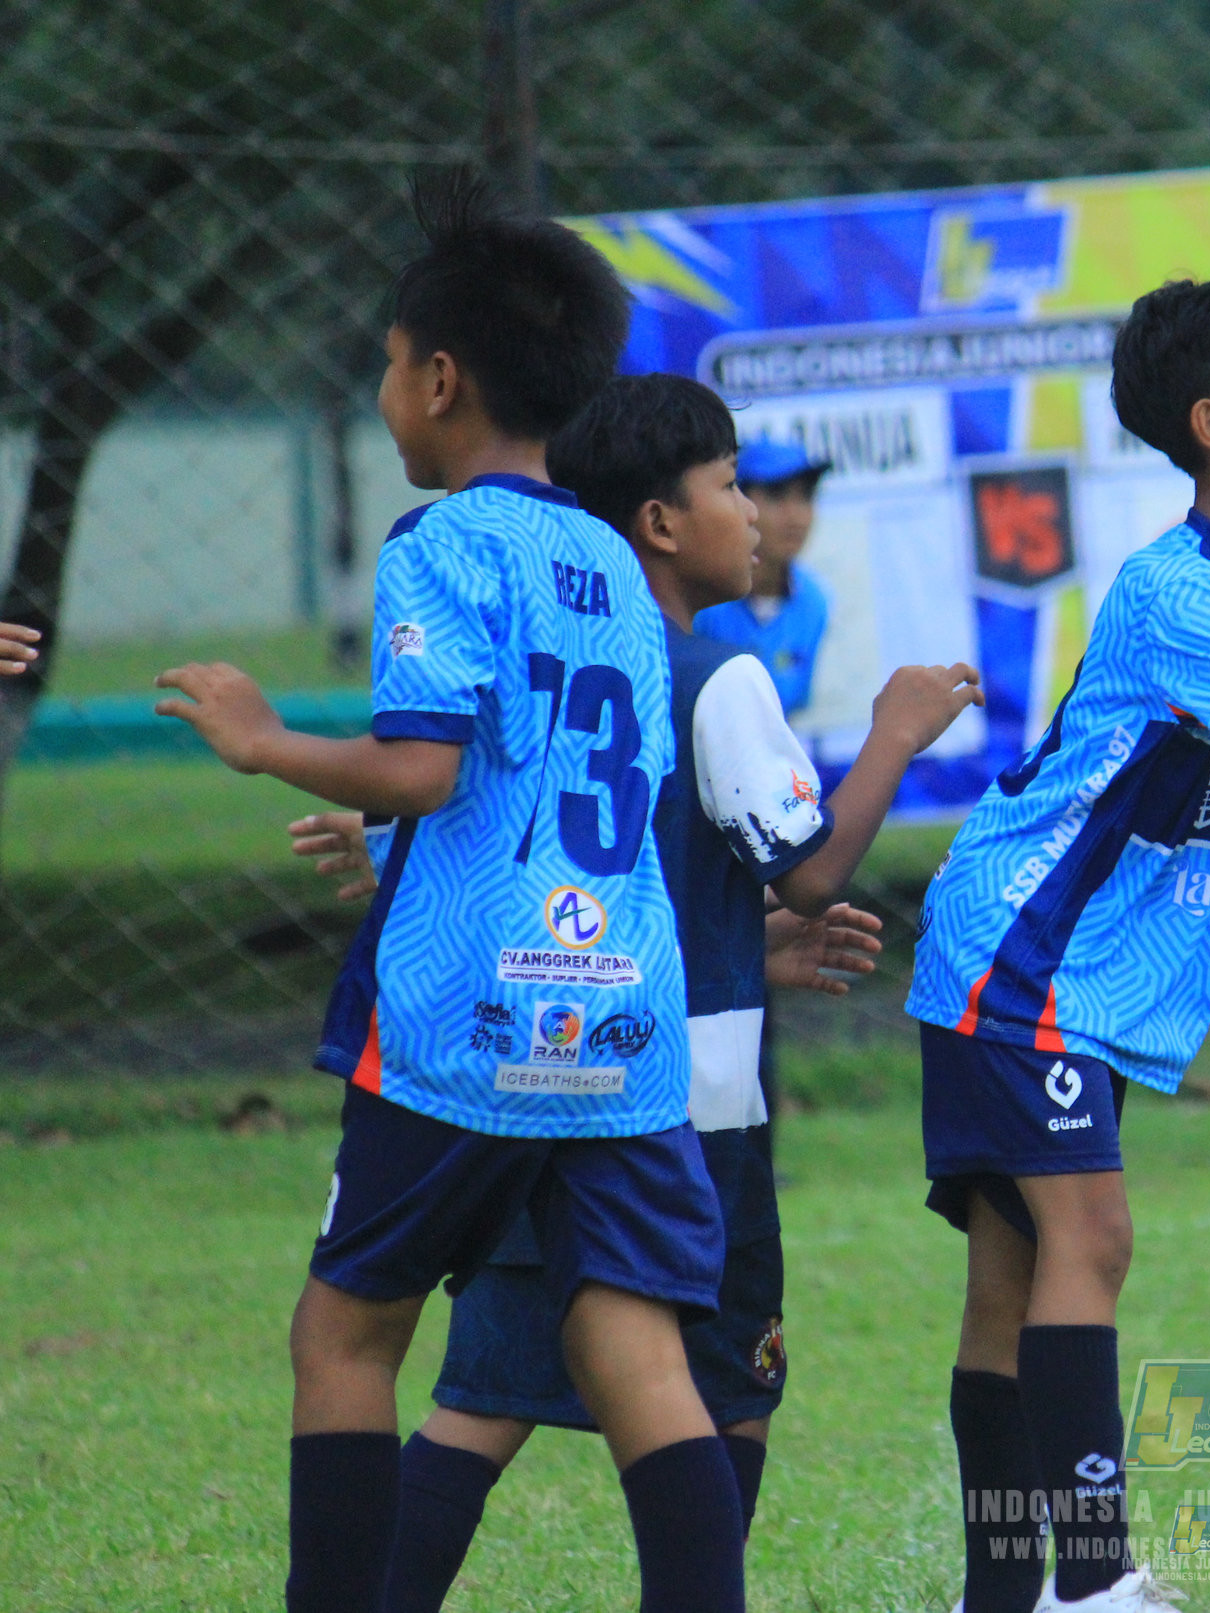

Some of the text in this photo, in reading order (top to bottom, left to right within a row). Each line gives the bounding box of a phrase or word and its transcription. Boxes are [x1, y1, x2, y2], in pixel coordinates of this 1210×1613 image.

[551, 560, 612, 618] REZA
[513, 652, 650, 877] 73
[1002, 856, 1050, 910] SSB
[501, 950, 592, 969] CV.ANGGREK
[534, 1046, 577, 1058] RAN
[1048, 1114, 1093, 1131] Güzel
